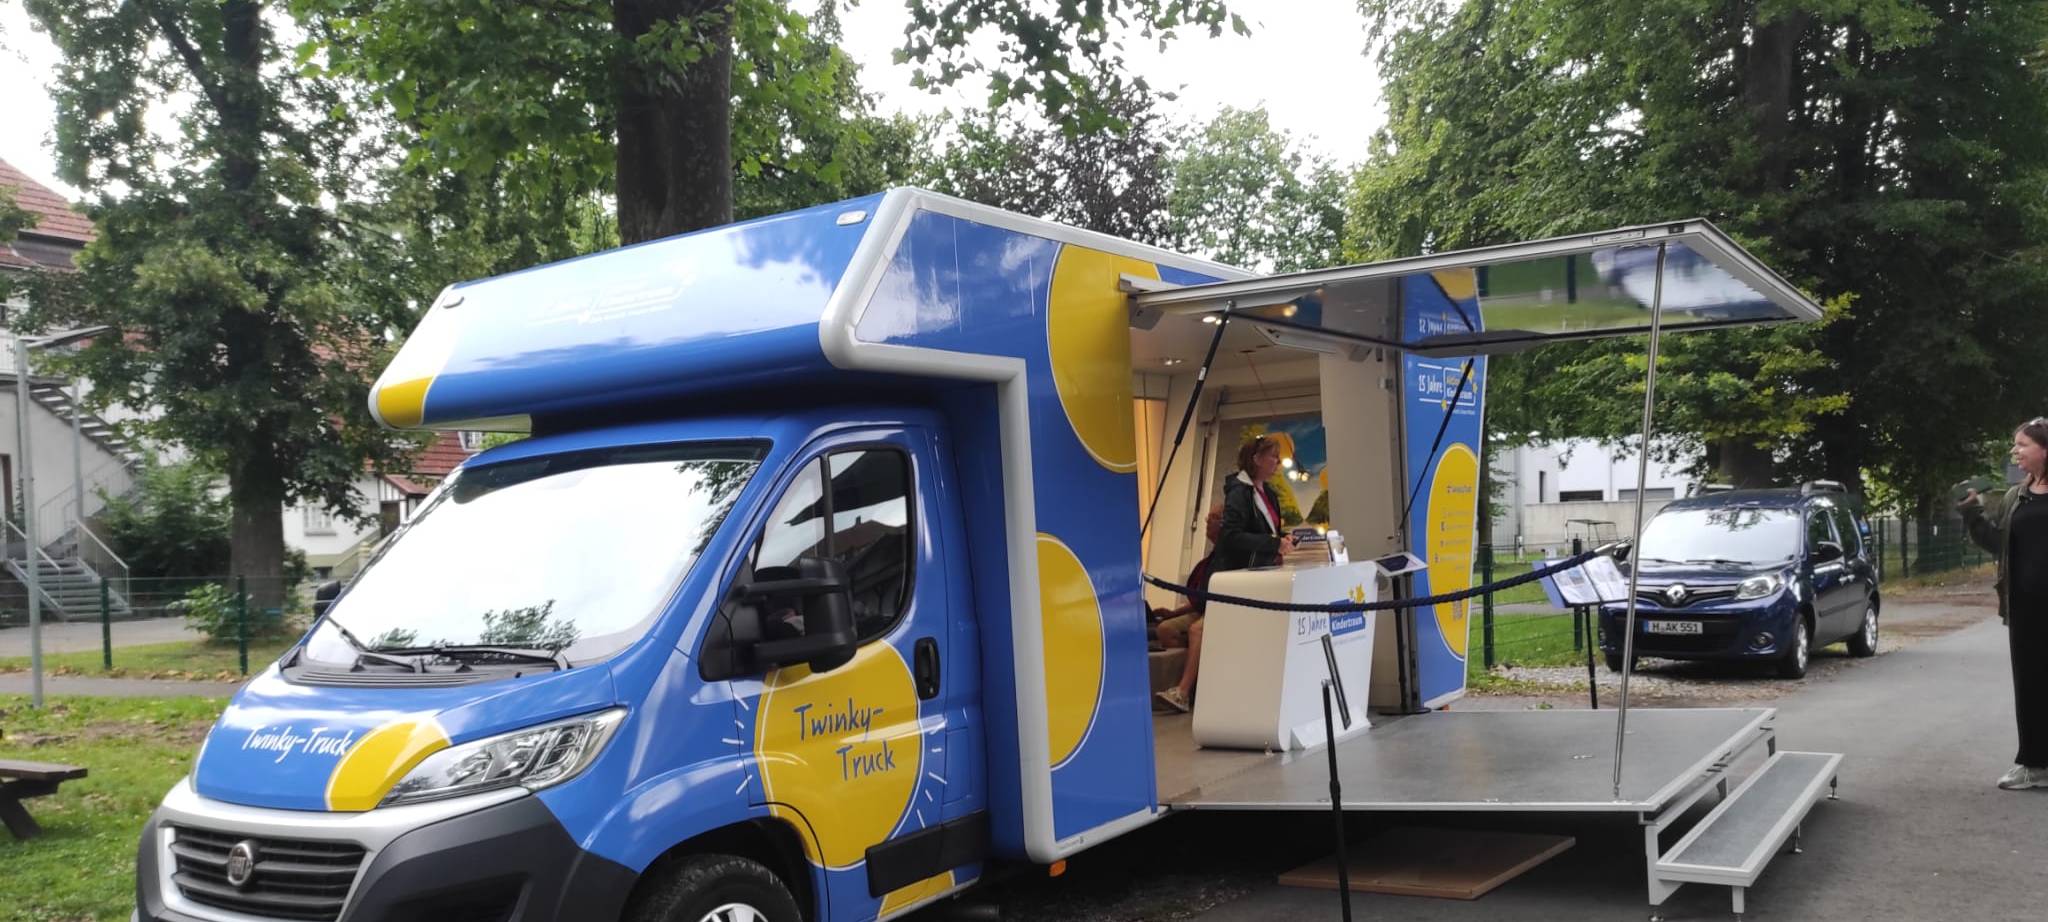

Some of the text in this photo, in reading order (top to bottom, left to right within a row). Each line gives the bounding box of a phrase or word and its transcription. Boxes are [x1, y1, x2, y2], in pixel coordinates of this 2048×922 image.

[1426, 375, 1443, 394] Jahre
[1307, 613, 1328, 636] Jahre
[1652, 622, 1660, 632] H
[793, 697, 884, 743] Twinky-
[241, 725, 354, 764] Twinky-Truck
[836, 739, 896, 781] Truck
